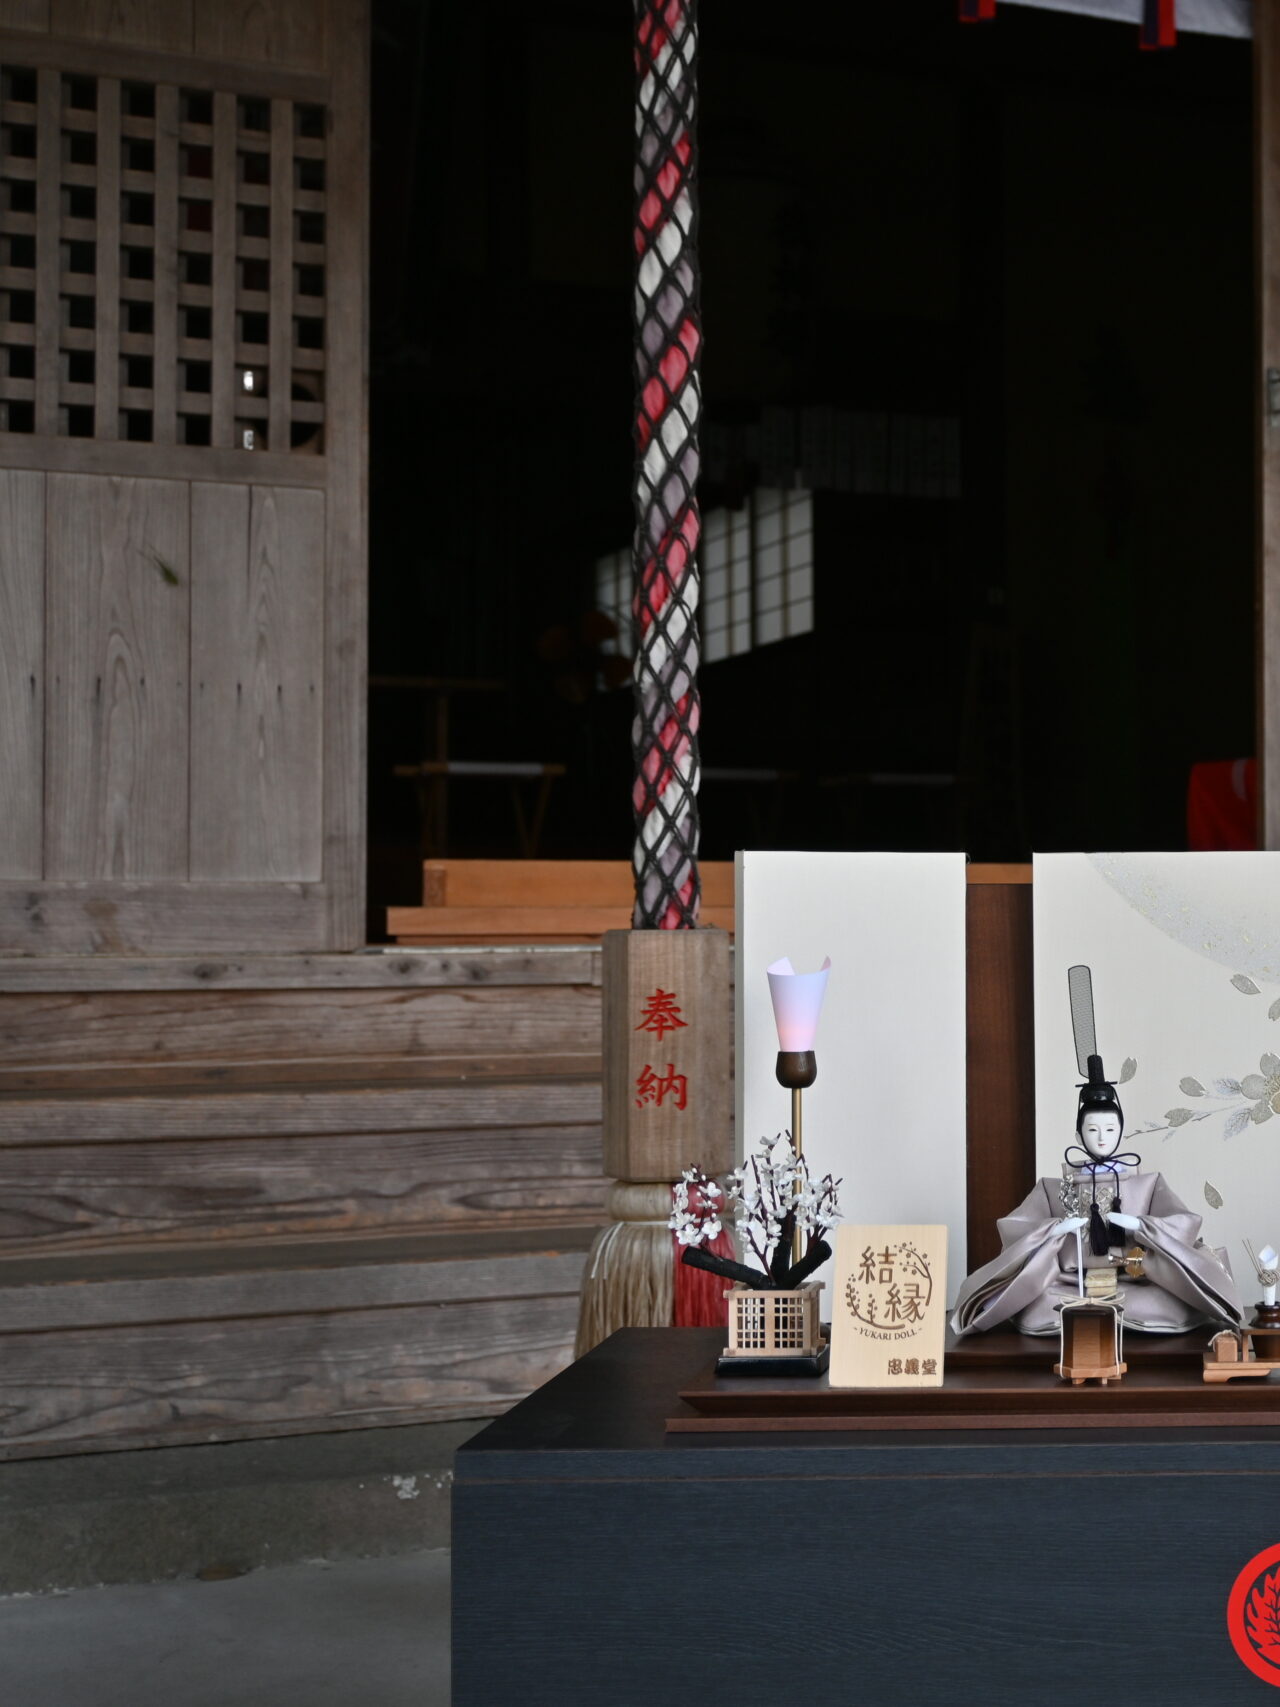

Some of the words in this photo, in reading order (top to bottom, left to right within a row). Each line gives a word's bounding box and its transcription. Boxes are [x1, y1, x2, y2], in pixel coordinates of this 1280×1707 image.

[634, 988, 689, 1111] 奉納
[859, 1327, 892, 1341] YUKARI
[894, 1329, 918, 1341] DOLL
[888, 1358, 938, 1376] 忠義堂
